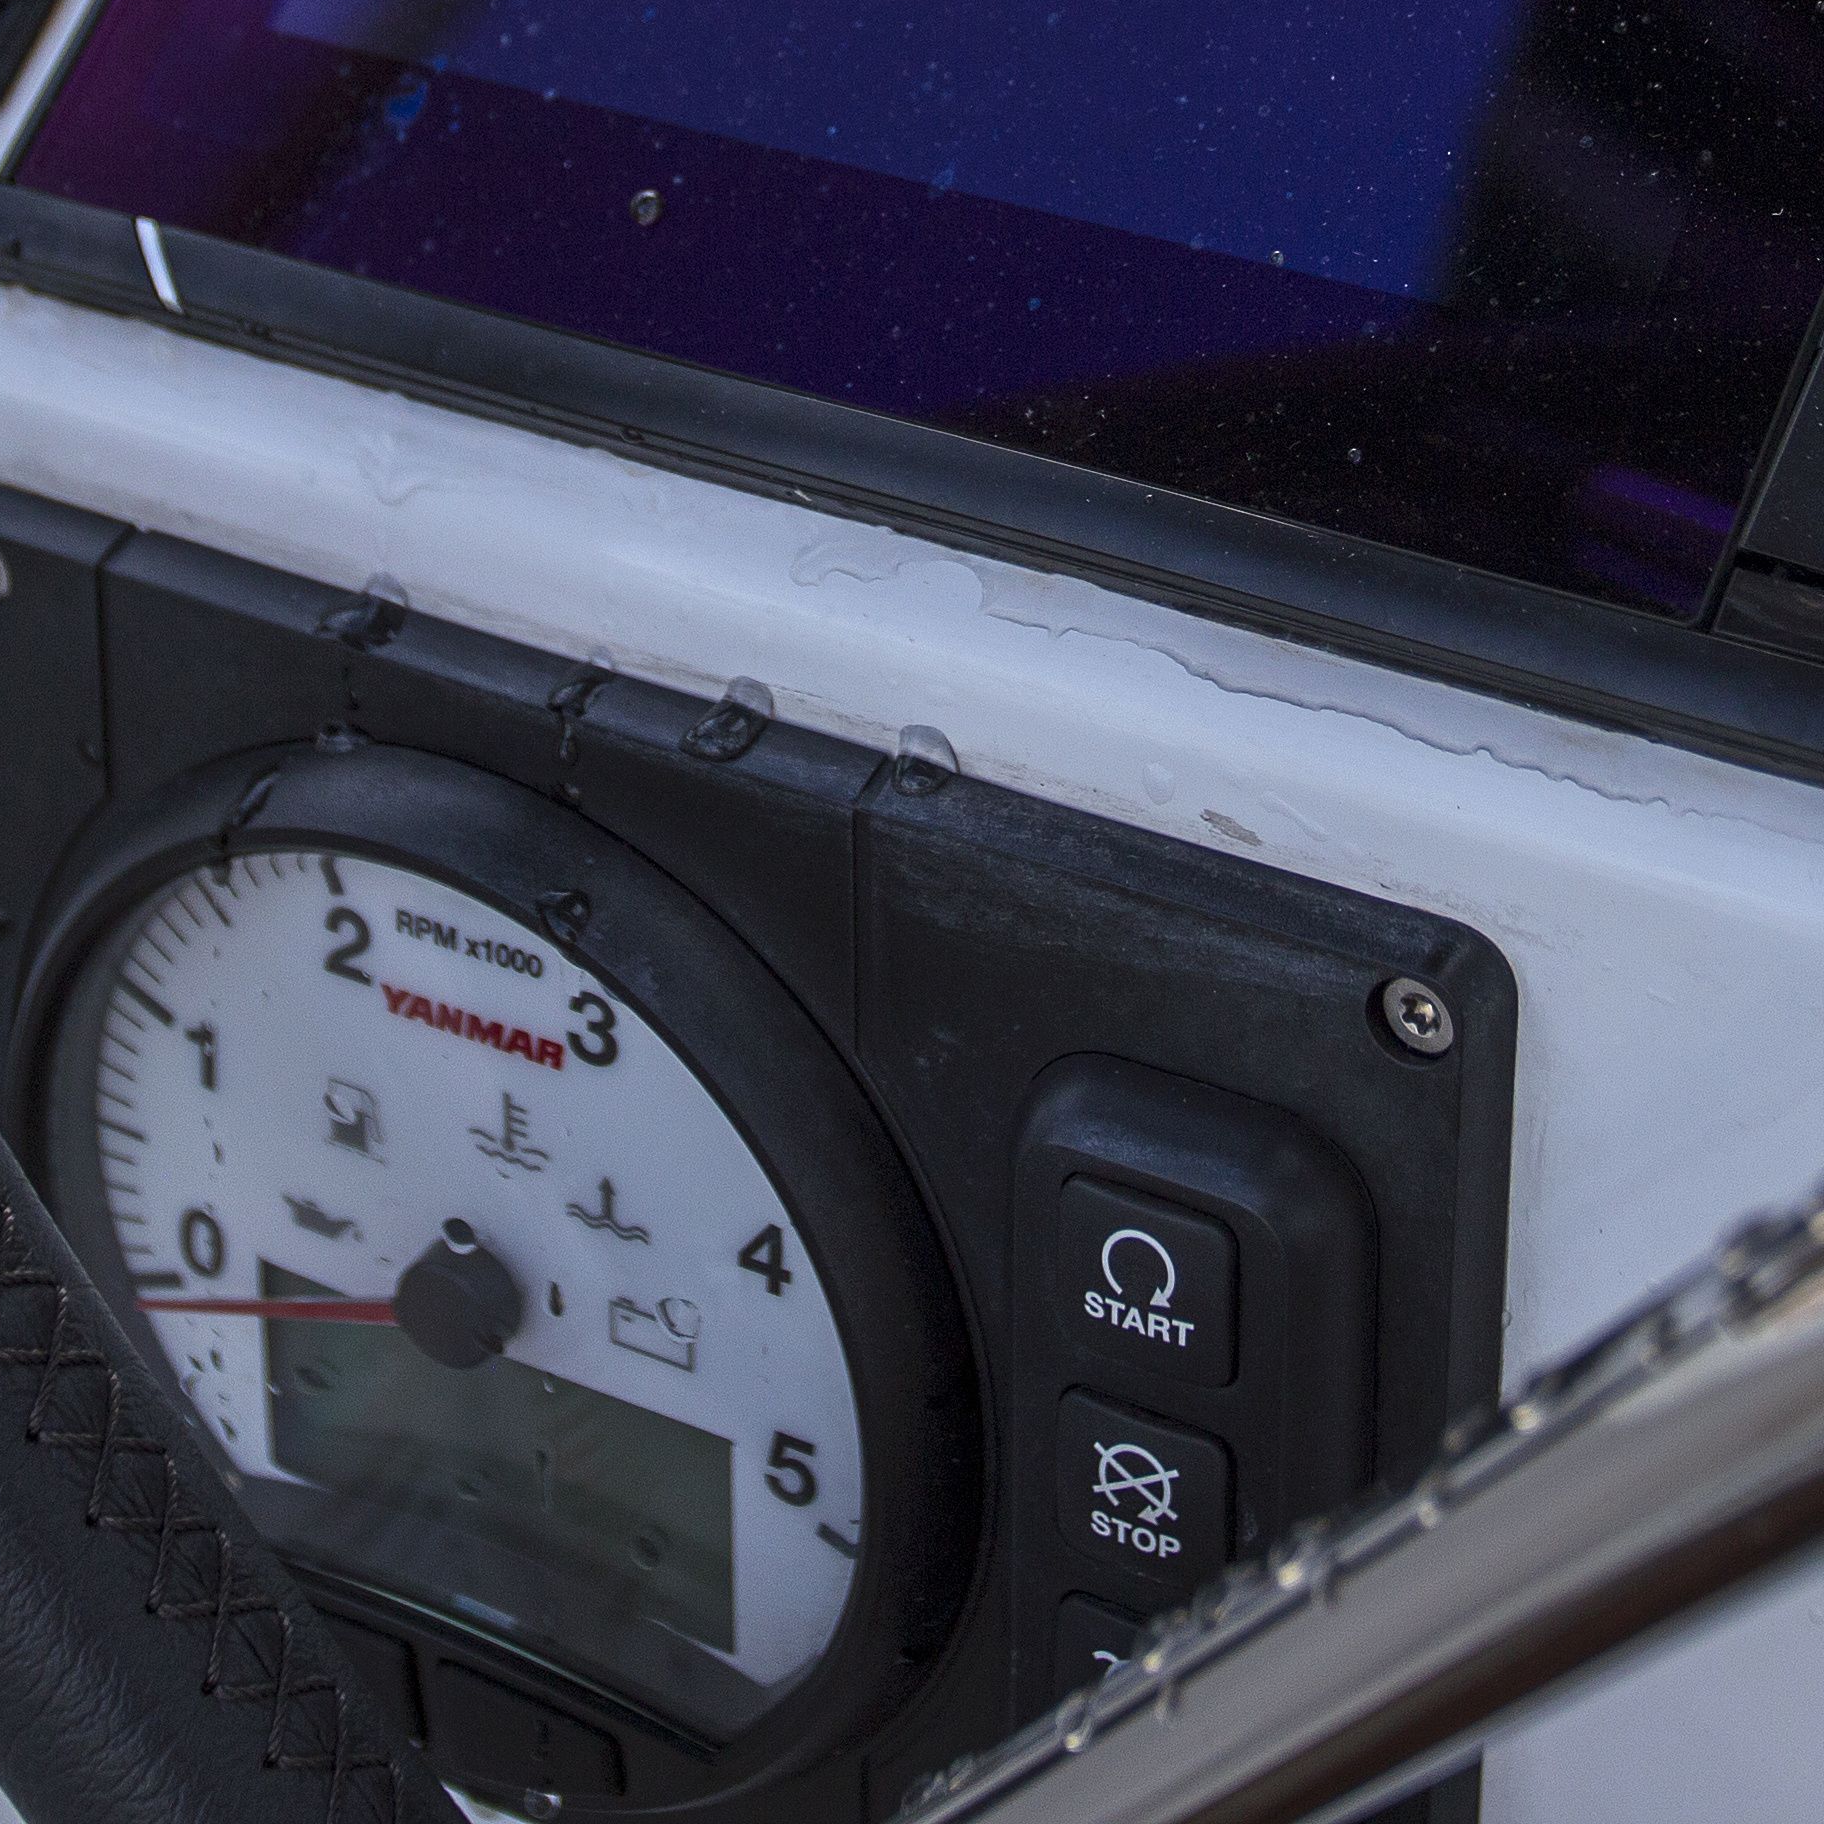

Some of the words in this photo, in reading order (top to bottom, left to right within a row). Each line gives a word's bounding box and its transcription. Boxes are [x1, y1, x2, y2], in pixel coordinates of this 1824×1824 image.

[325, 906, 371, 987] 2
[395, 908, 457, 952] RPM
[464, 936, 544, 979] x1000
[184, 1023, 217, 1091] 1
[379, 982, 565, 1071] YANMAR
[567, 990, 619, 1067] 3
[180, 1207, 225, 1278] 0
[737, 1223, 792, 1297] 4
[1084, 1291, 1195, 1347] START
[764, 1430, 817, 1508] 5
[1090, 1510, 1181, 1558] STOP
